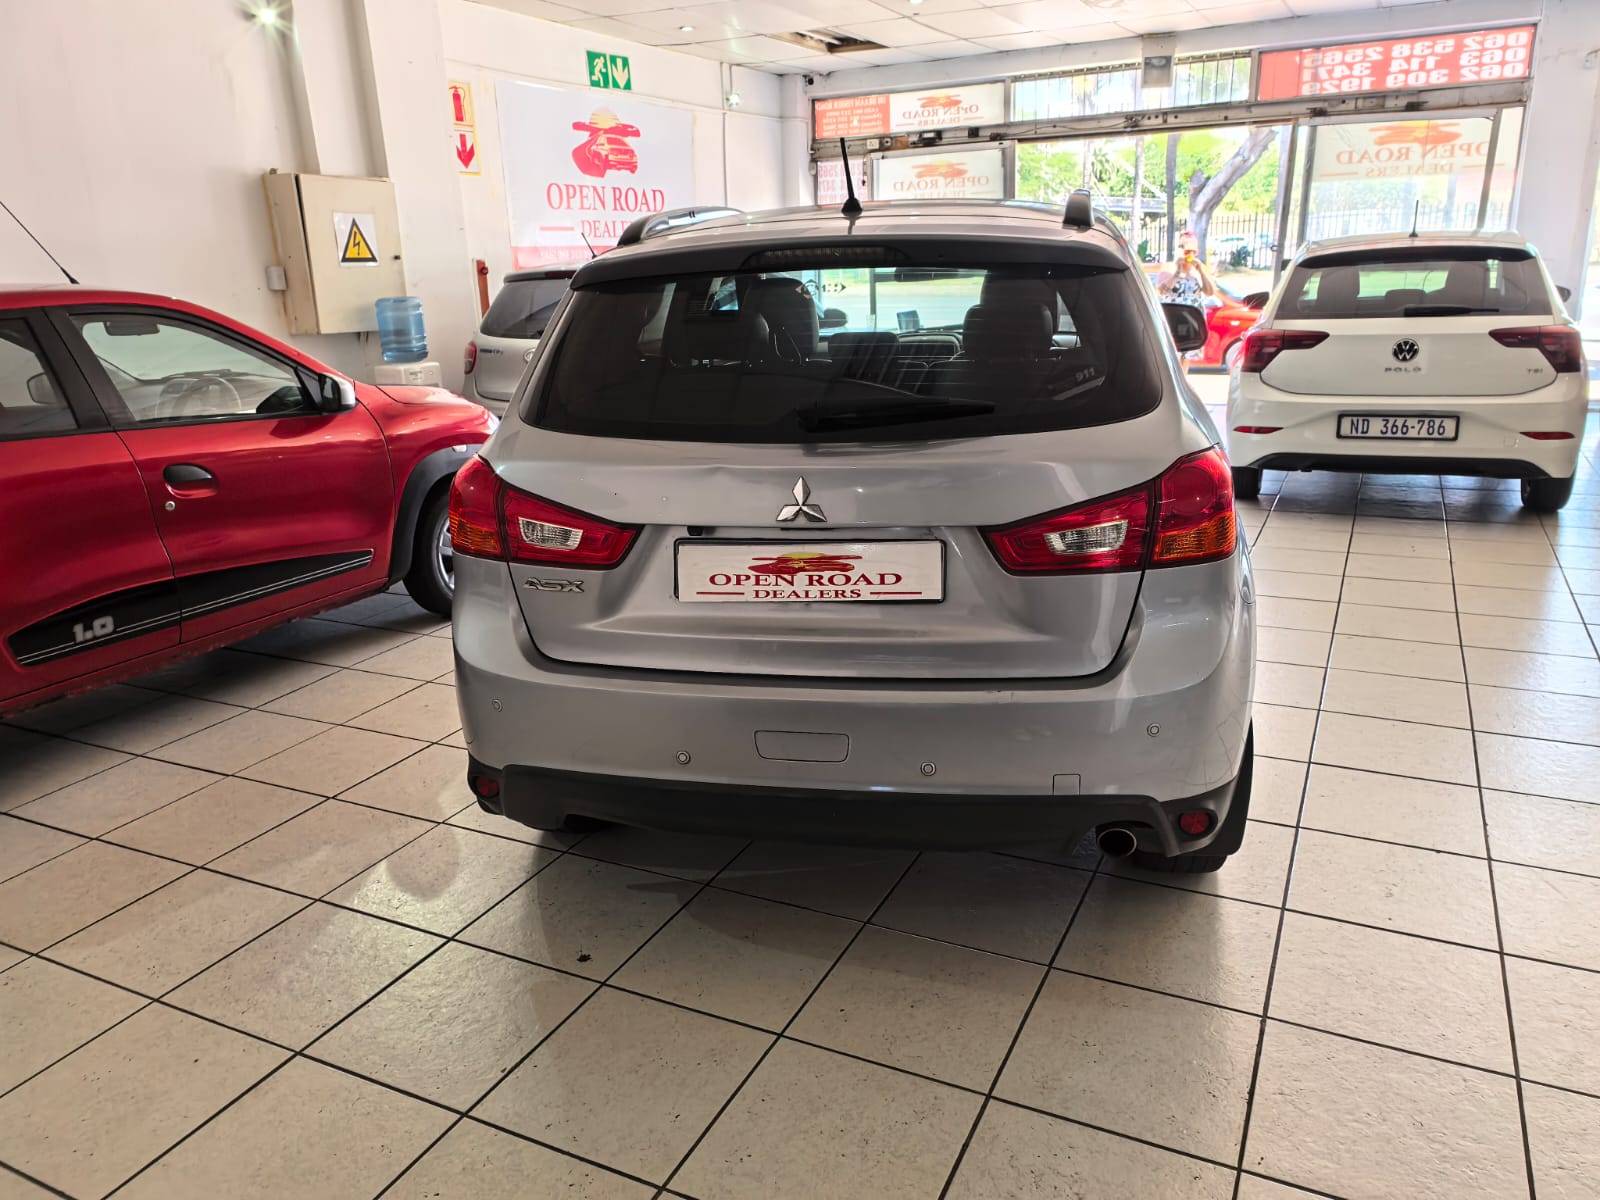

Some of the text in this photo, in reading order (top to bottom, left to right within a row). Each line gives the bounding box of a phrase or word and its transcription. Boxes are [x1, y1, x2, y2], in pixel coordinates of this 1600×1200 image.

[546, 182, 666, 213] OPEN ROAD
[1384, 366, 1422, 374] POLO
[1349, 418, 1447, 437] ND 366-786
[523, 576, 585, 594] ASX
[708, 573, 904, 588] OPEN ROAD
[752, 588, 863, 600] DEALERS
[72, 615, 116, 644] 1.0
